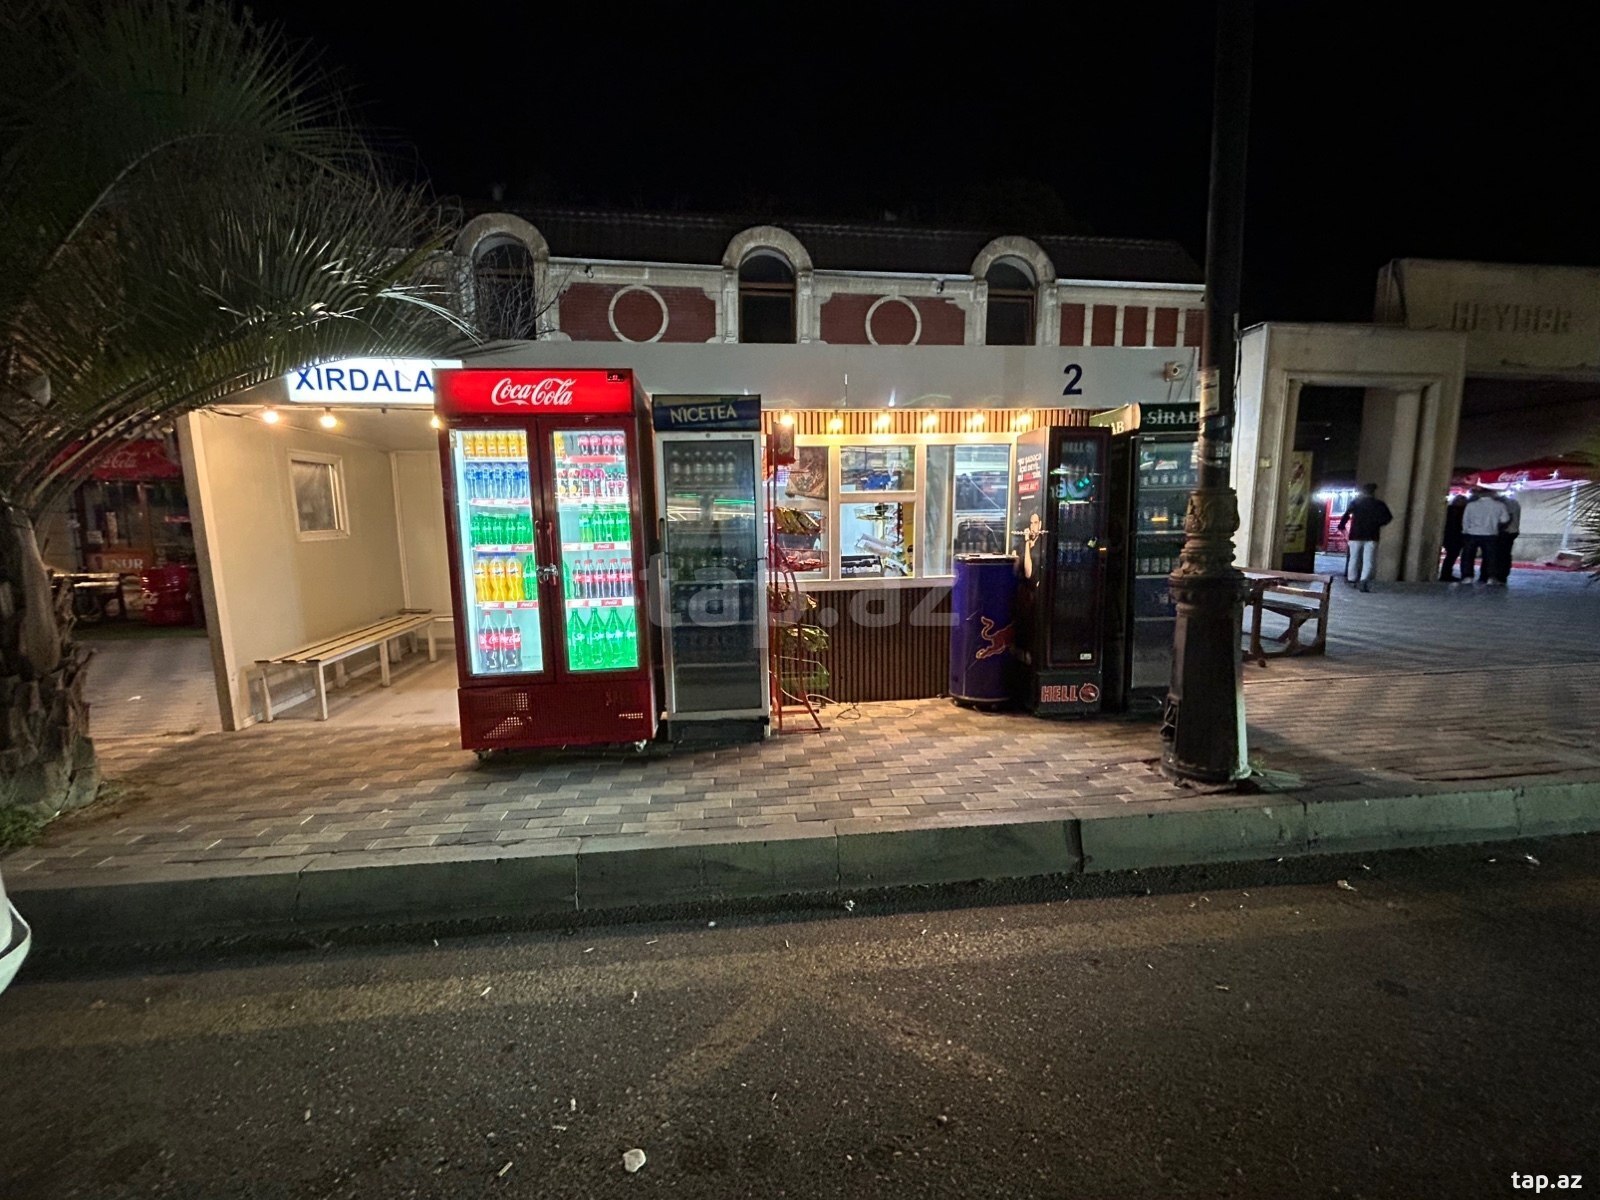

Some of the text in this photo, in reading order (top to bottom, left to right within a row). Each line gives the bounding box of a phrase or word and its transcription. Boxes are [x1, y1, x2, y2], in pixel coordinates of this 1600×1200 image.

[491, 377, 577, 406] Coca-Cola
[1062, 363, 1083, 396] 2
[1040, 685, 1079, 703] HELL
